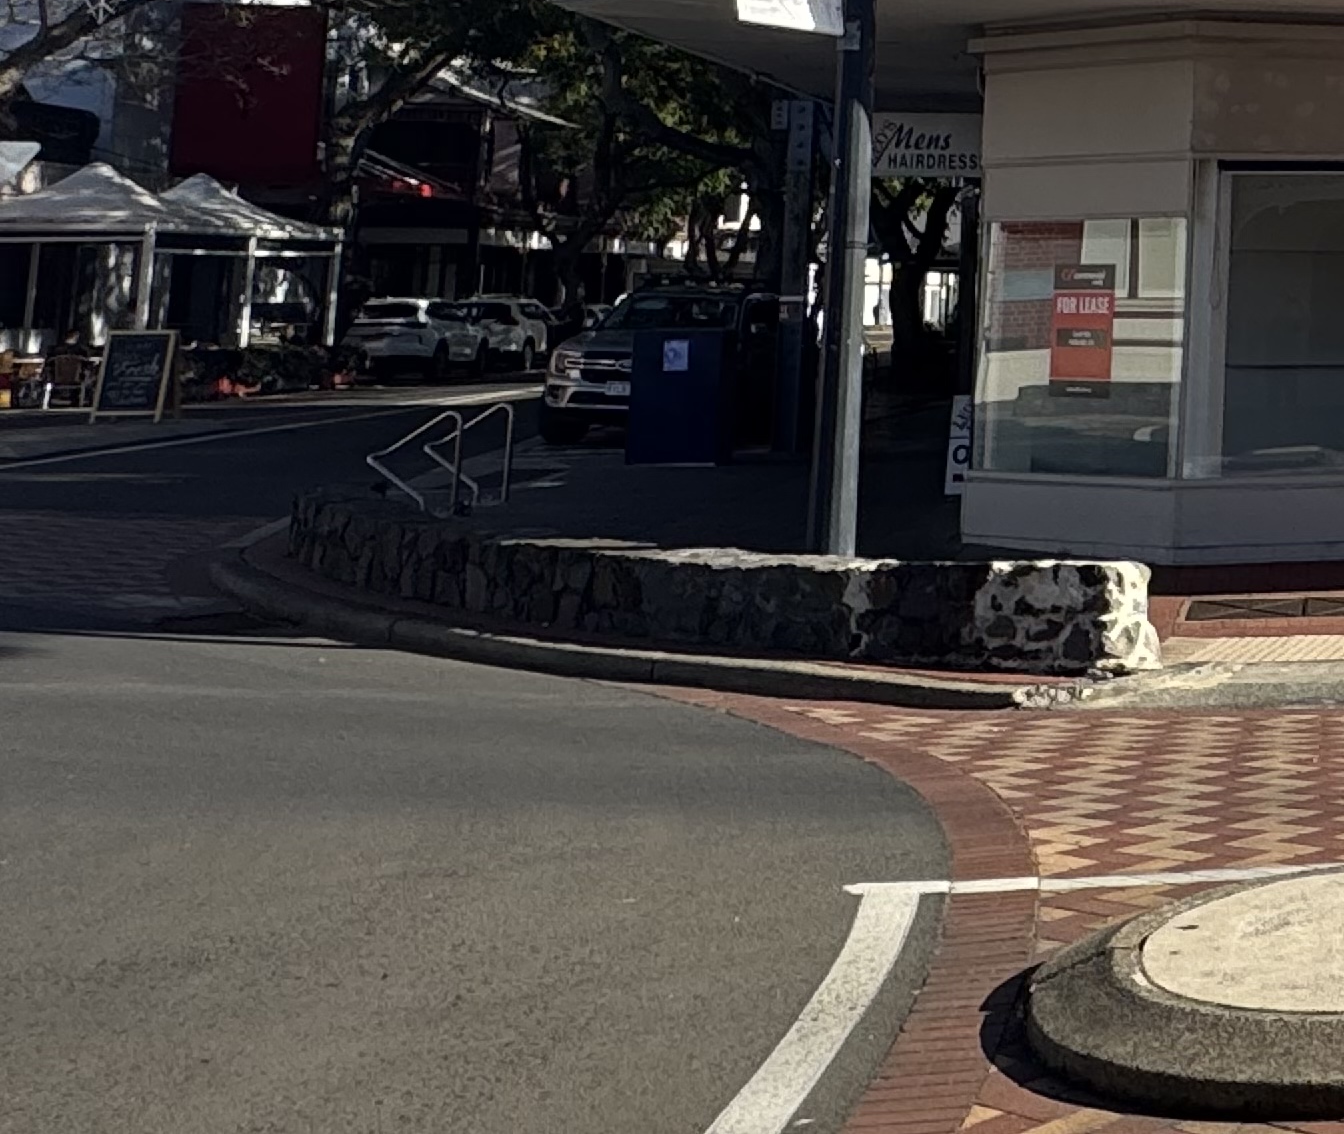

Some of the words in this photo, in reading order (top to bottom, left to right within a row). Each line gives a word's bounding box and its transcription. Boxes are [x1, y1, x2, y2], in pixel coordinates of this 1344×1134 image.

[893, 122, 953, 151] Mens
[888, 152, 979, 170] HAIRDRESS
[1056, 296, 1078, 314] FOR
[1079, 296, 1110, 314] LEASE
